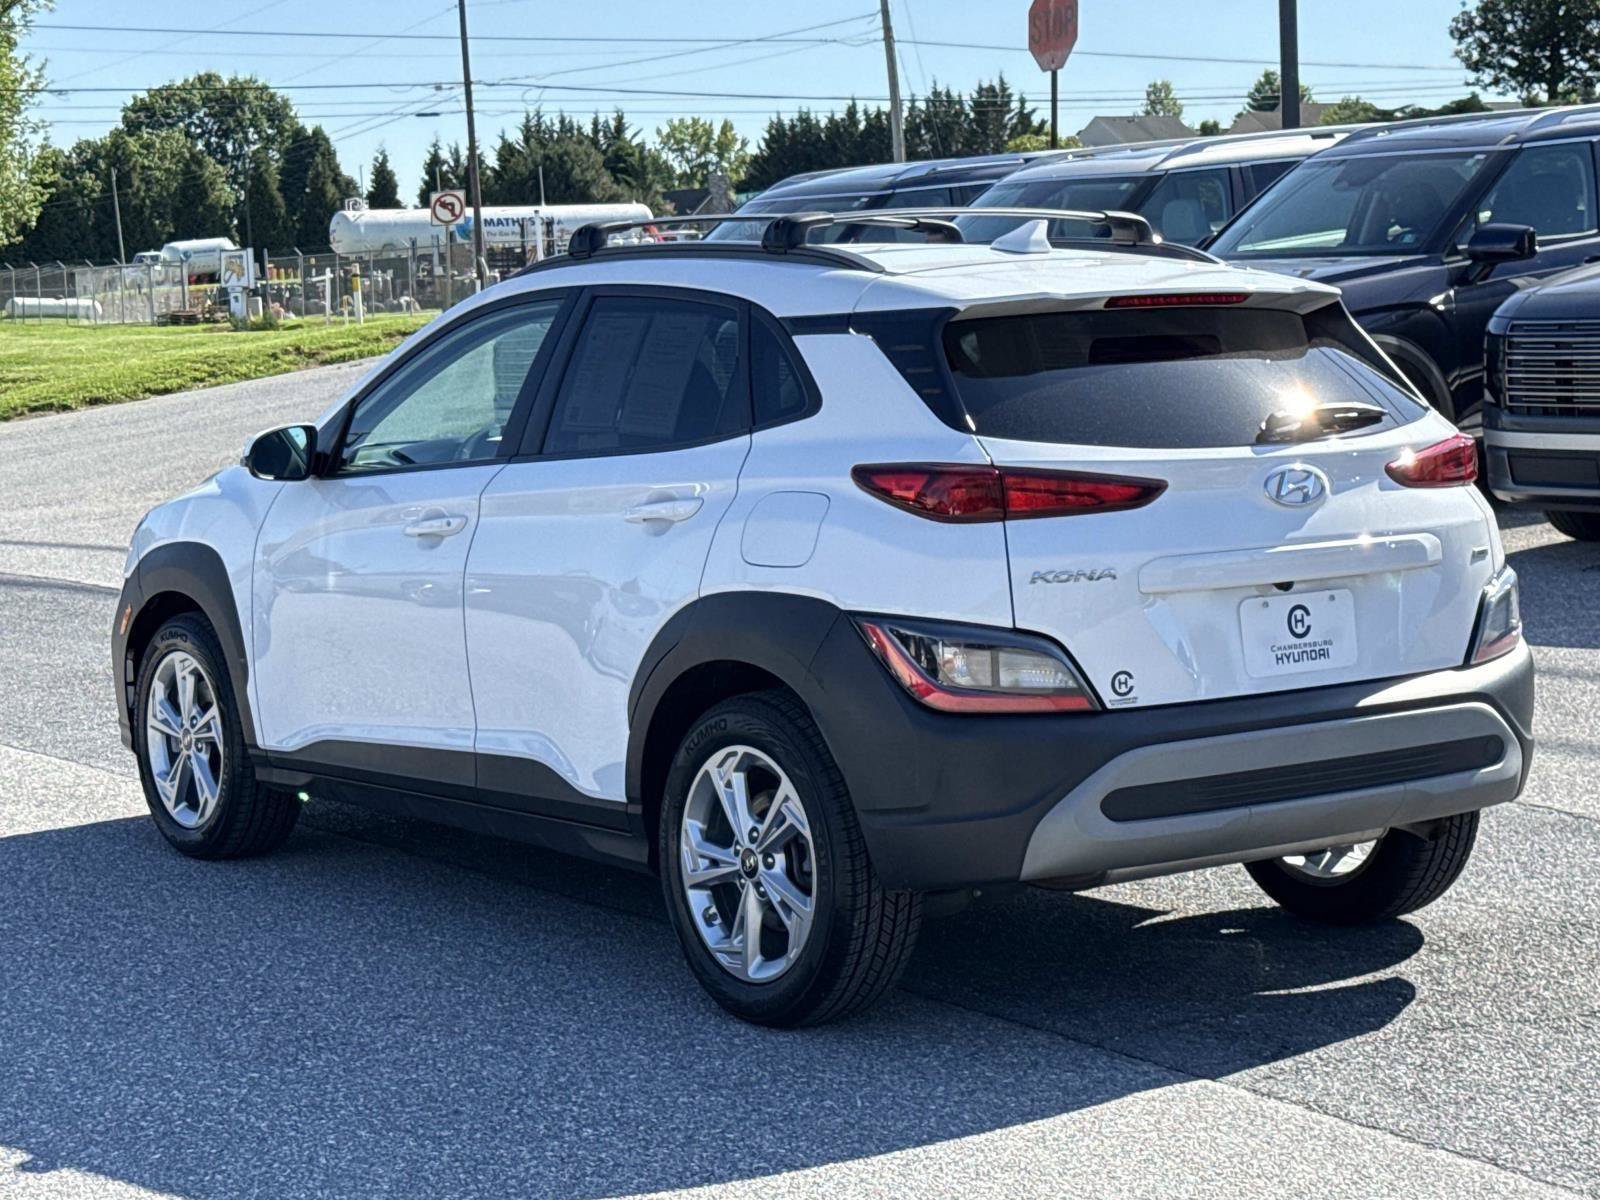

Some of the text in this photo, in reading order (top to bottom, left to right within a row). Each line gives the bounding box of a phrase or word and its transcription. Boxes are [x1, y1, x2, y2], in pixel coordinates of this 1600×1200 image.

[1031, 5, 1075, 45] STOP
[1029, 567, 1117, 585] KONA
[1275, 647, 1331, 666] HYUNDAI
[684, 718, 728, 757] KUMHO
